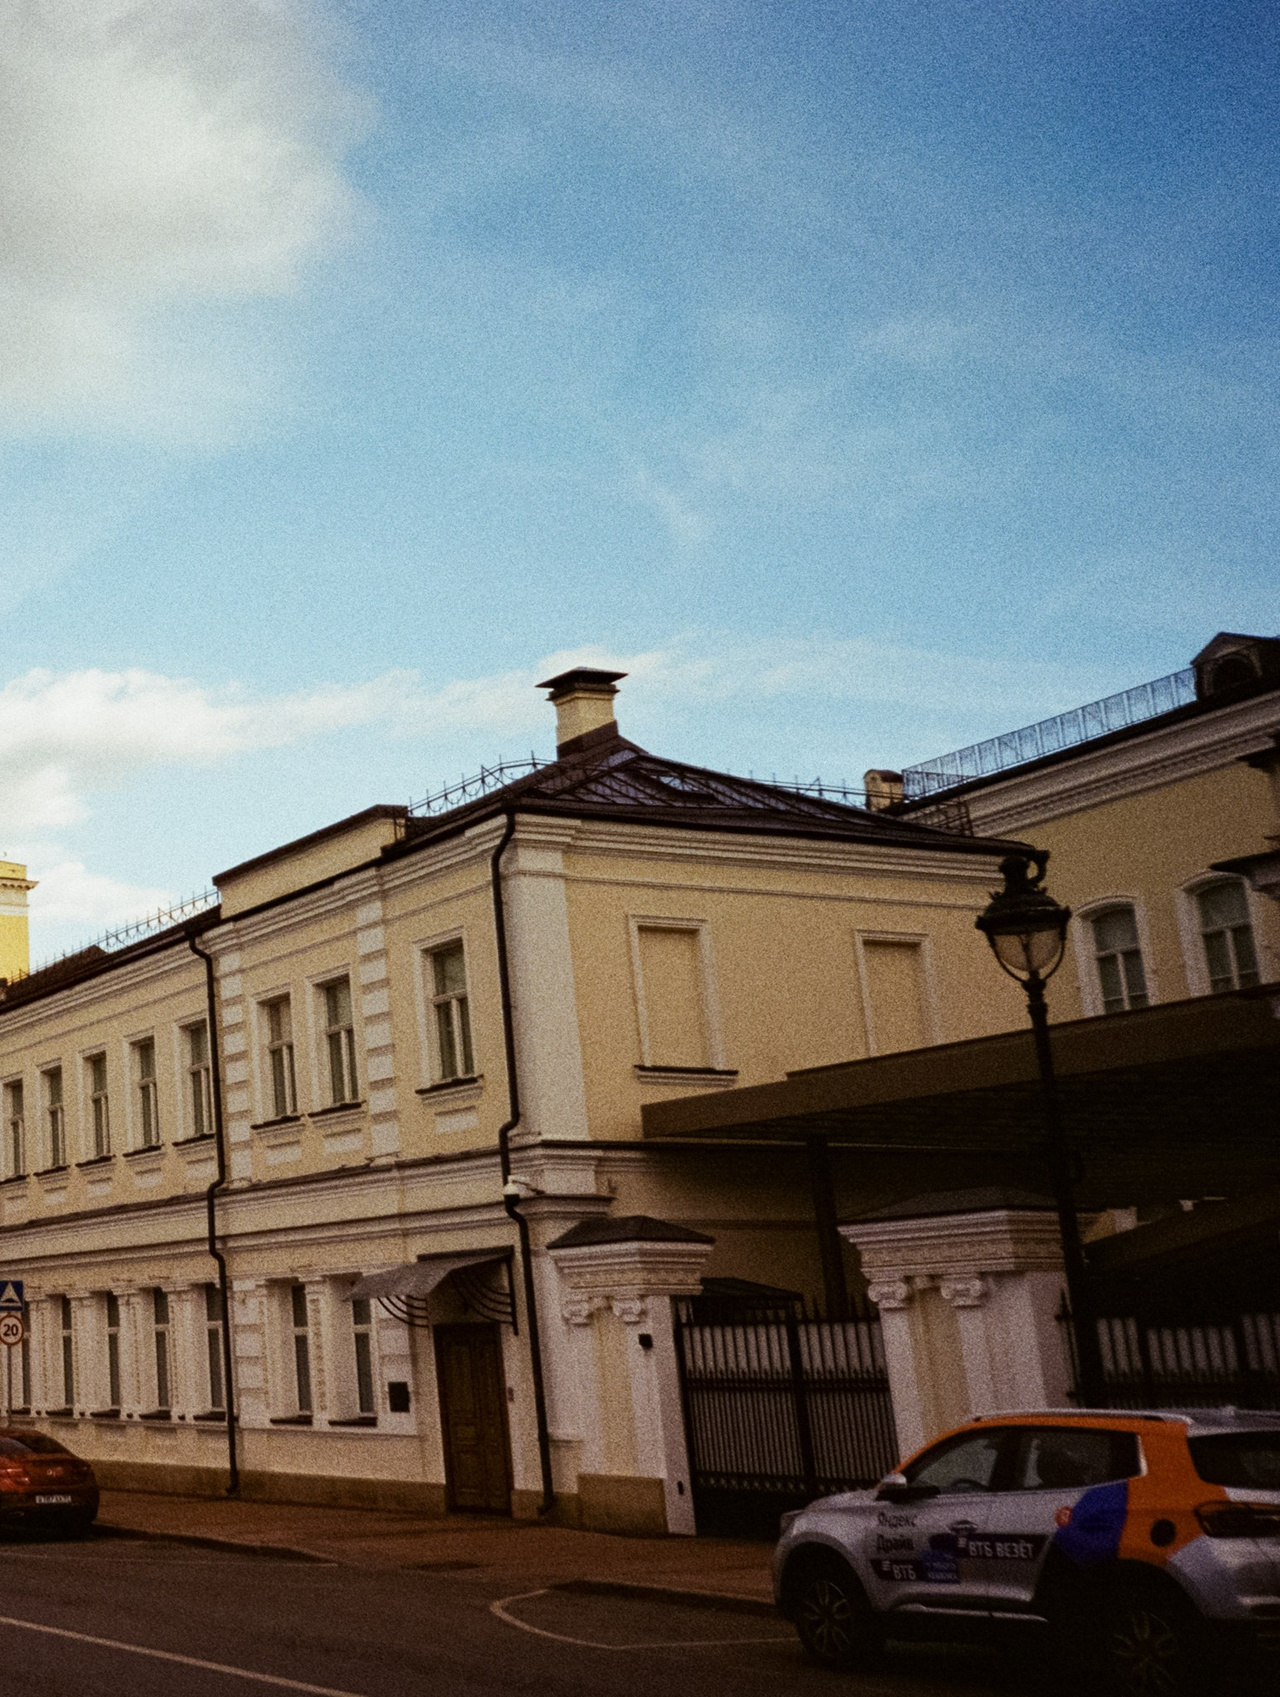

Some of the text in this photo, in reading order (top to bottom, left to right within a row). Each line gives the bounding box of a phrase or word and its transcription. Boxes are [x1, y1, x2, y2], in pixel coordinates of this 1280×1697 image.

[3, 1324, 19, 1336] 20
[968, 1541, 993, 1557] ВТБ
[892, 1564, 917, 1580] ВТБ
